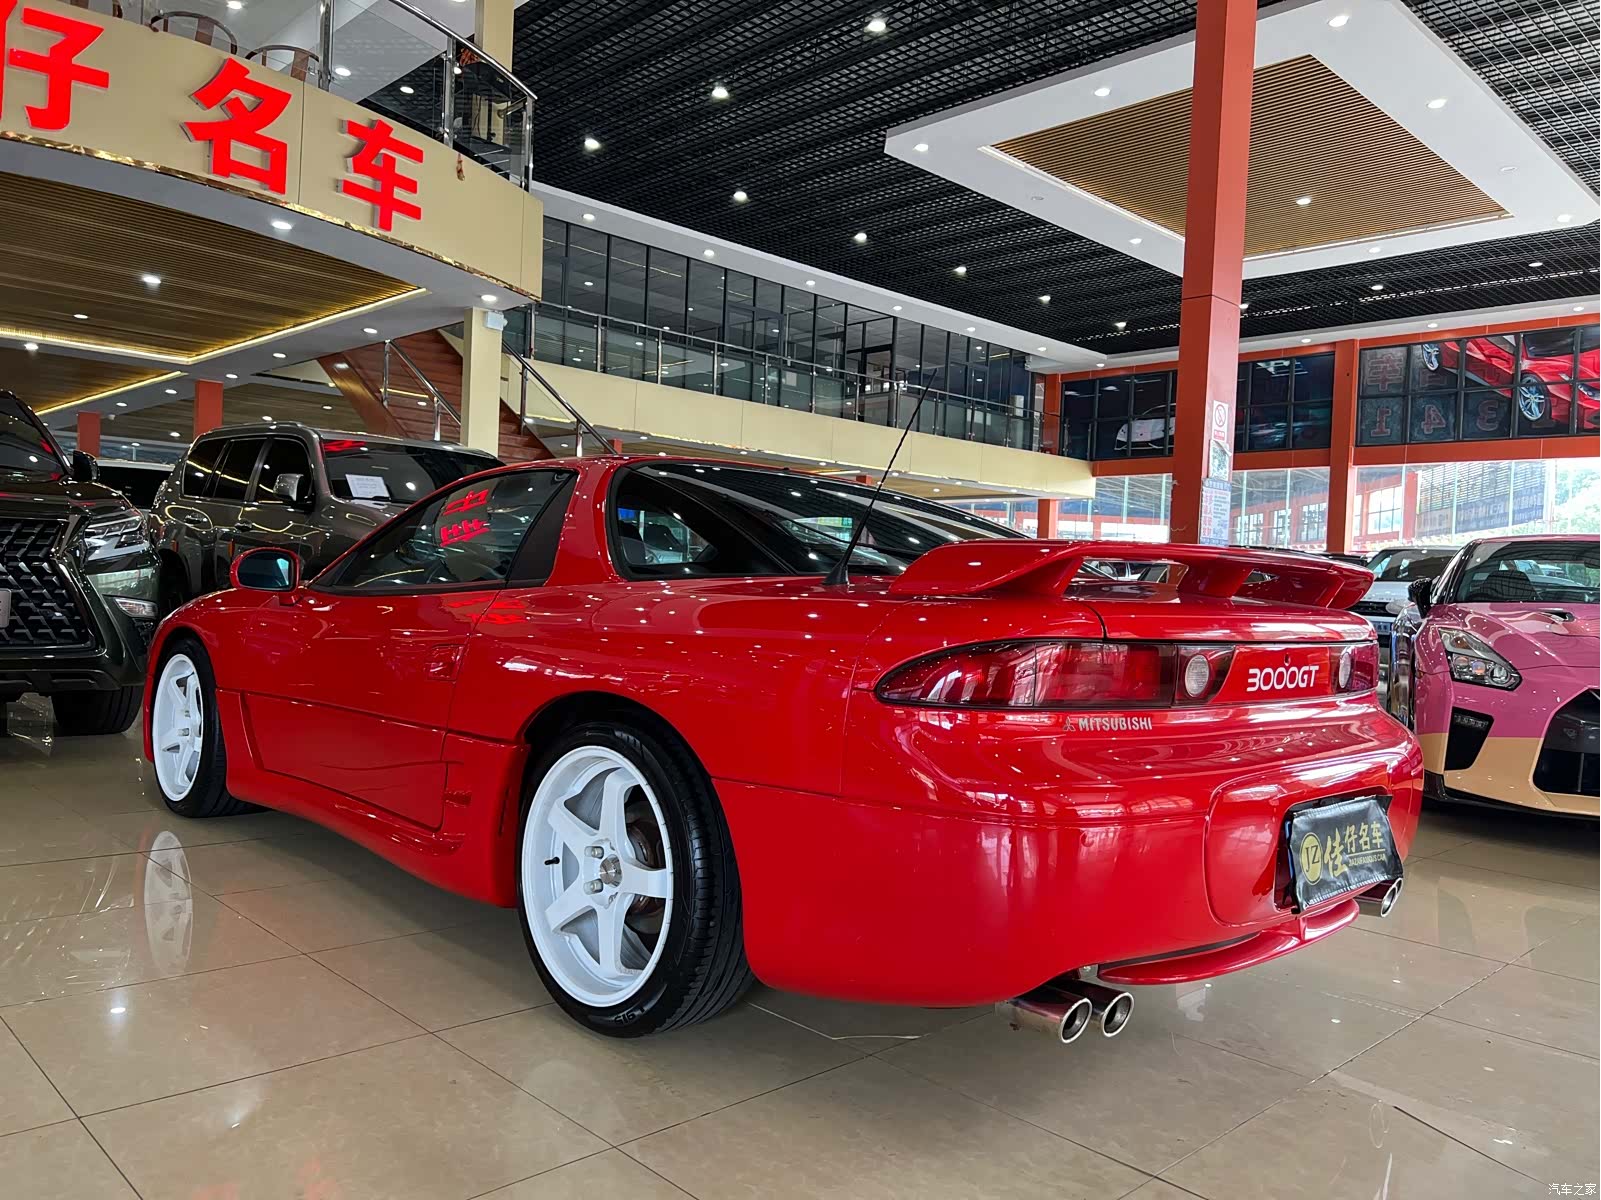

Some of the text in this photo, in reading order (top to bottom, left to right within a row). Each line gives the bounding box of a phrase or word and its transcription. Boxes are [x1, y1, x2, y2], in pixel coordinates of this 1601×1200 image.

[1246, 665, 1319, 692] 3000GT
[1078, 717, 1152, 732] MITSUBISHI
[1305, 845, 1320, 872] JZ
[1324, 821, 1384, 878] 佳仔名车
